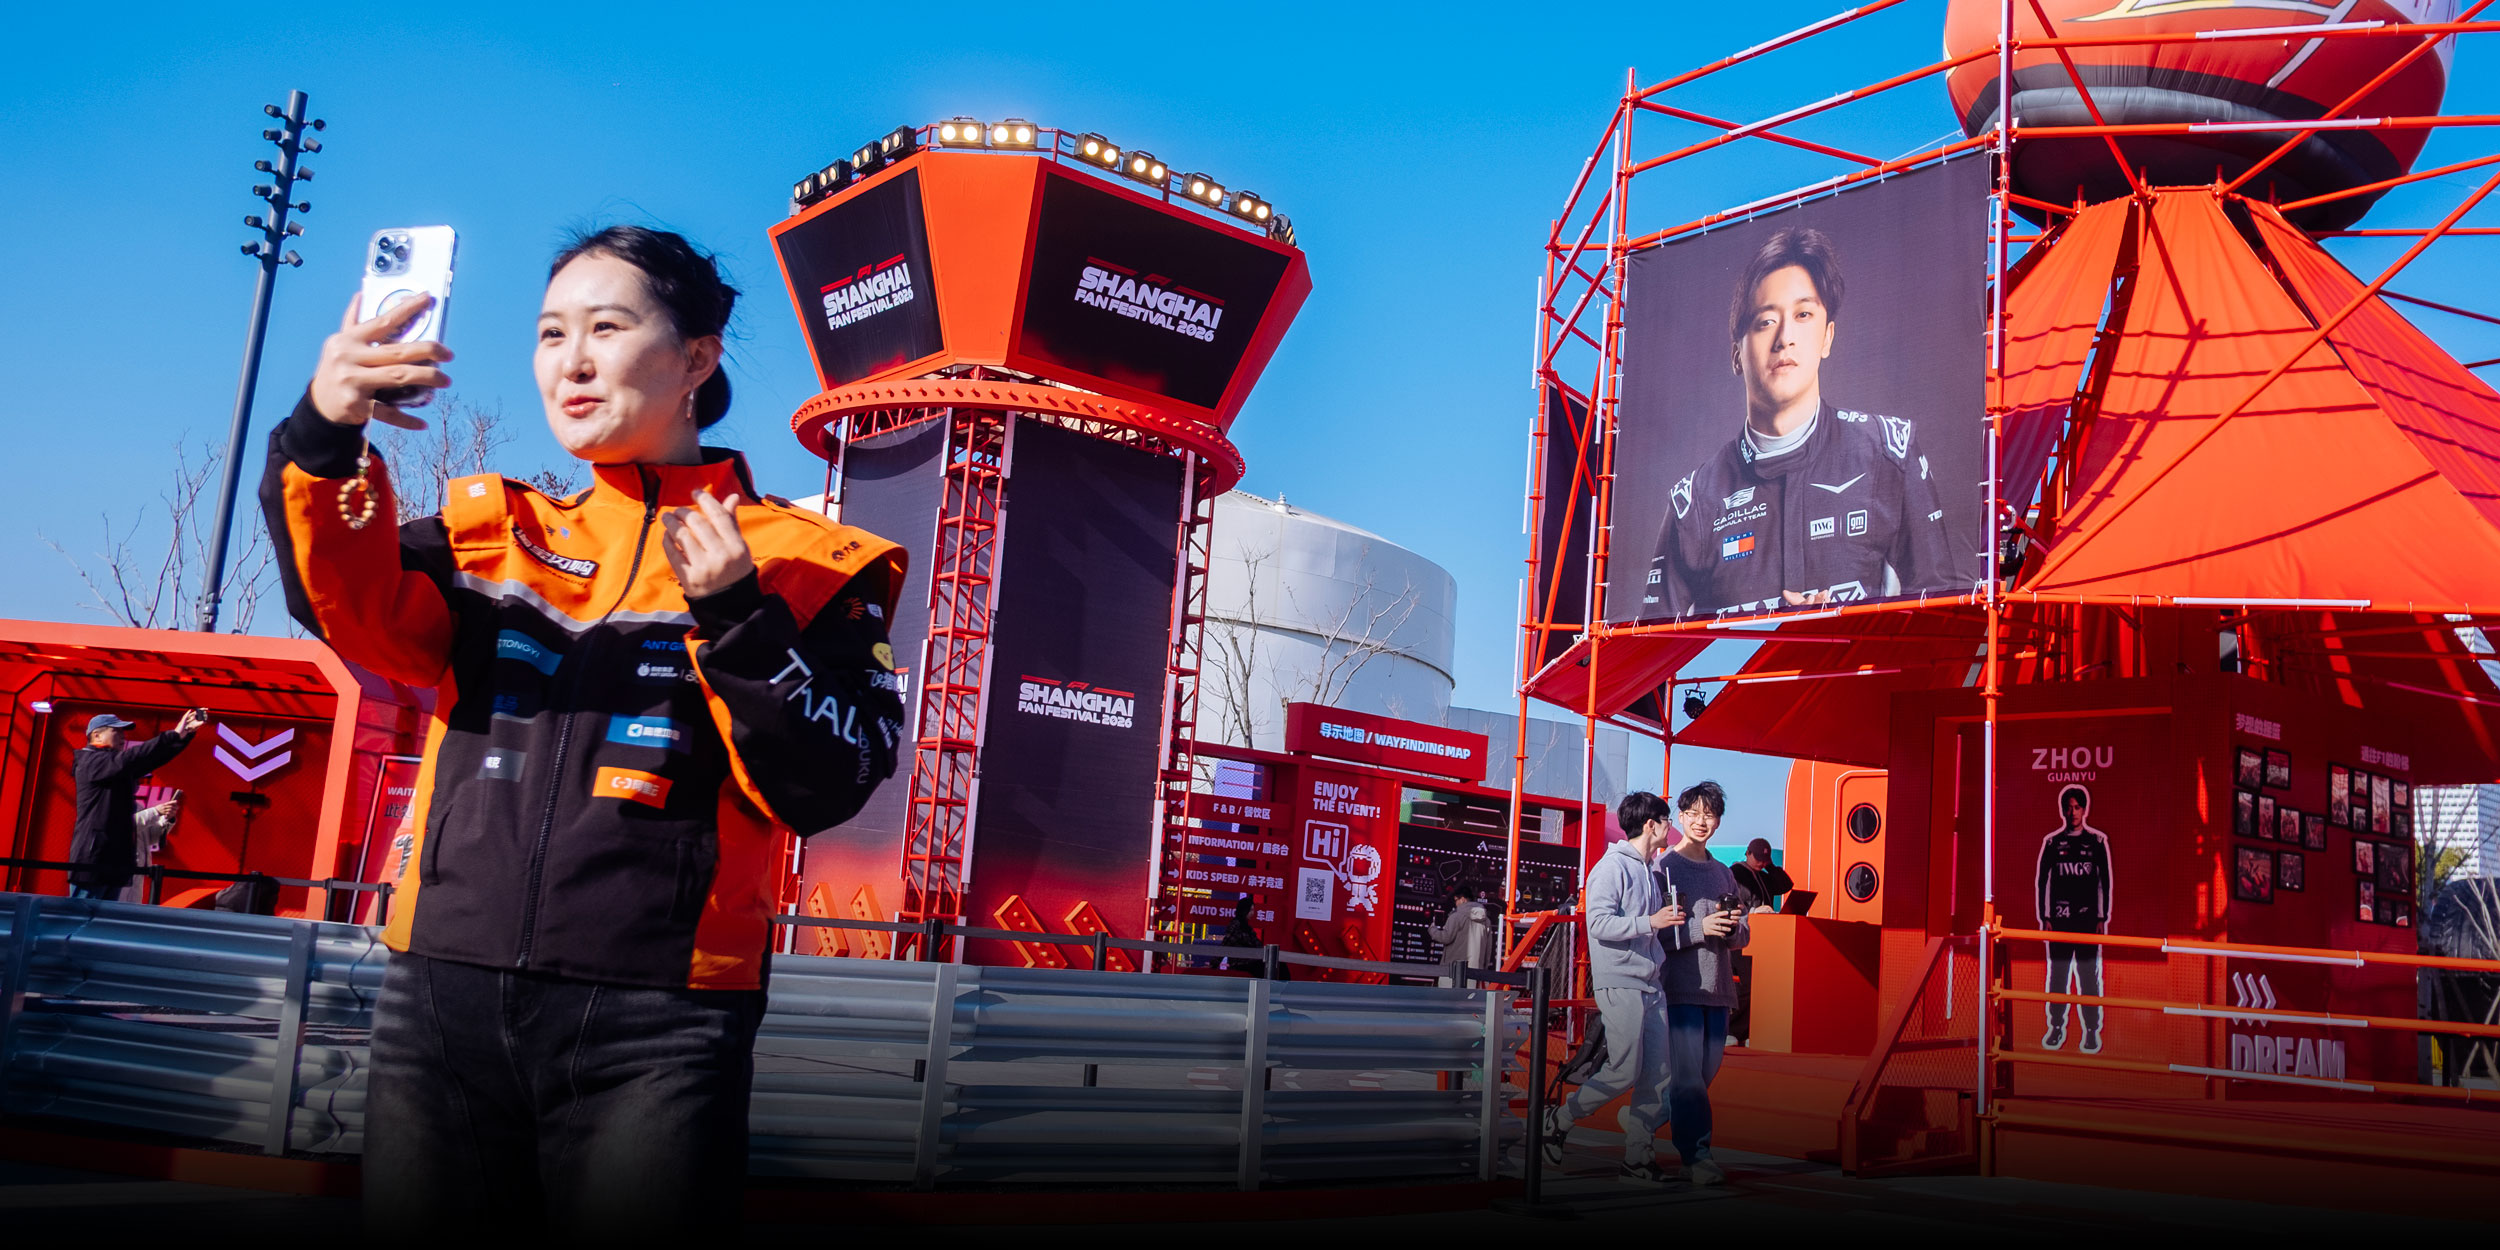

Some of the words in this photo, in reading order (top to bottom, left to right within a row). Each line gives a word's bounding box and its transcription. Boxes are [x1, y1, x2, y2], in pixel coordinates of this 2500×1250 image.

[823, 262, 911, 317] SHANGHAI
[1079, 266, 1223, 329] SHANGHAI
[828, 312, 851, 331] FAN
[850, 296, 893, 323] FESTIVAL
[892, 286, 914, 307] 2026
[1074, 288, 1109, 310] FAN
[1108, 298, 1176, 331] FESTIVAL
[1176, 320, 1215, 343] 2026
[1713, 503, 1767, 526] CADILLAC
[1713, 518, 1742, 532] FORMULA
[1748, 511, 1767, 520] TEAM
[1813, 521, 1832, 532] TWG
[1850, 516, 1864, 530] gm
[1725, 532, 1753, 542] TOMMY
[1724, 550, 1753, 561] HILFIGER
[641, 640, 669, 651] ANT
[1019, 682, 1135, 717] SHANGHAI
[1018, 701, 1045, 716] FAN
[1045, 705, 1101, 724] FESTIVAL
[1101, 714, 1133, 729] 2026
[1374, 733, 1445, 756] WAYFINDING
[1445, 745, 1471, 760] MAP
[2031, 746, 2114, 770] ZHOU
[2047, 771, 2096, 782] GUANYU
[1314, 781, 1359, 800] ENJOY
[1213, 803, 1220, 812] F
[1220, 804, 1227, 813] &
[1229, 805, 1235, 814] B
[1313, 798, 1335, 813] THE
[1188, 834, 1254, 851] INFORMATION
[1262, 843, 1289, 856] 服务台
[1312, 829, 1340, 858] Hi
[1186, 869, 1208, 881] KIDS
[1210, 872, 1239, 884] SPEED
[2056, 862, 2083, 876] TWG
[1190, 905, 1217, 917] AUTO
[1219, 907, 1236, 918] SHO
[1257, 909, 1275, 922] 车展
[2055, 905, 2071, 918] 24
[2232, 1033, 2346, 1080] DREAM
